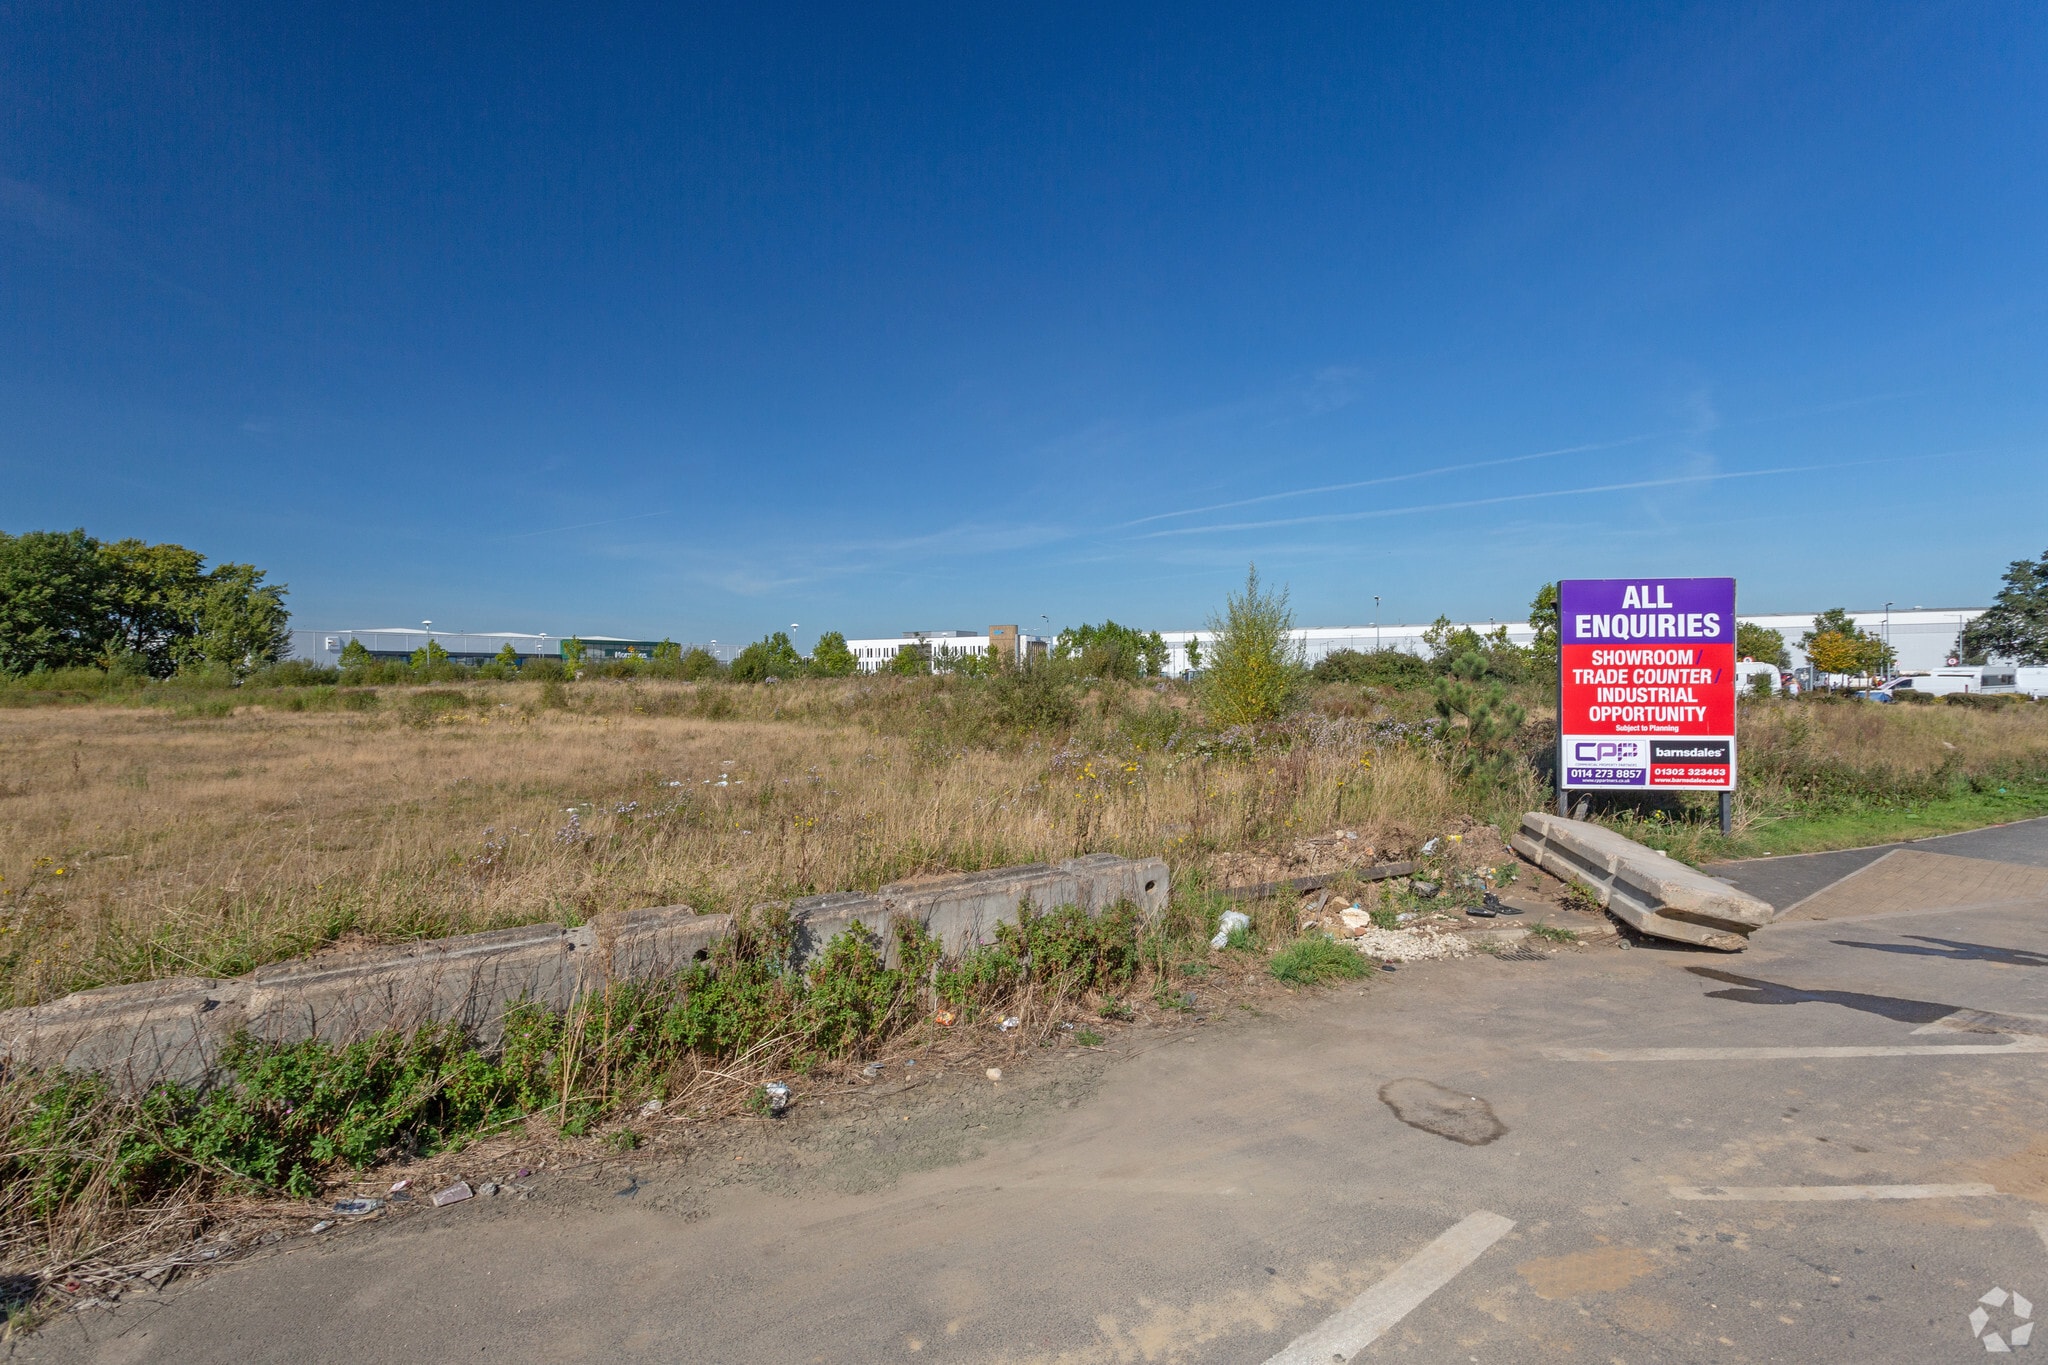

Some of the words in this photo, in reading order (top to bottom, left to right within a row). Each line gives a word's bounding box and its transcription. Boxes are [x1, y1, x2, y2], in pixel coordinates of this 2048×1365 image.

[1622, 585, 1673, 609] ALL
[1575, 613, 1720, 640] ENQUIRIES
[1591, 649, 1693, 666] SHOWROOM
[1573, 669, 1628, 685] TRADE
[1633, 668, 1712, 685] COUNTER
[1597, 687, 1698, 703] INDUSTRIAL
[1589, 706, 1706, 722] OPPORTUNITY
[1616, 724, 1640, 733] Subject
[1641, 724, 1648, 732] to
[1649, 724, 1679, 733] Planning
[1571, 769, 1593, 778] 0114
[1595, 769, 1613, 778] 273
[1616, 769, 1642, 778] 8857
[1654, 768, 1685, 776] 01302
[1687, 768, 1726, 776] 323453
